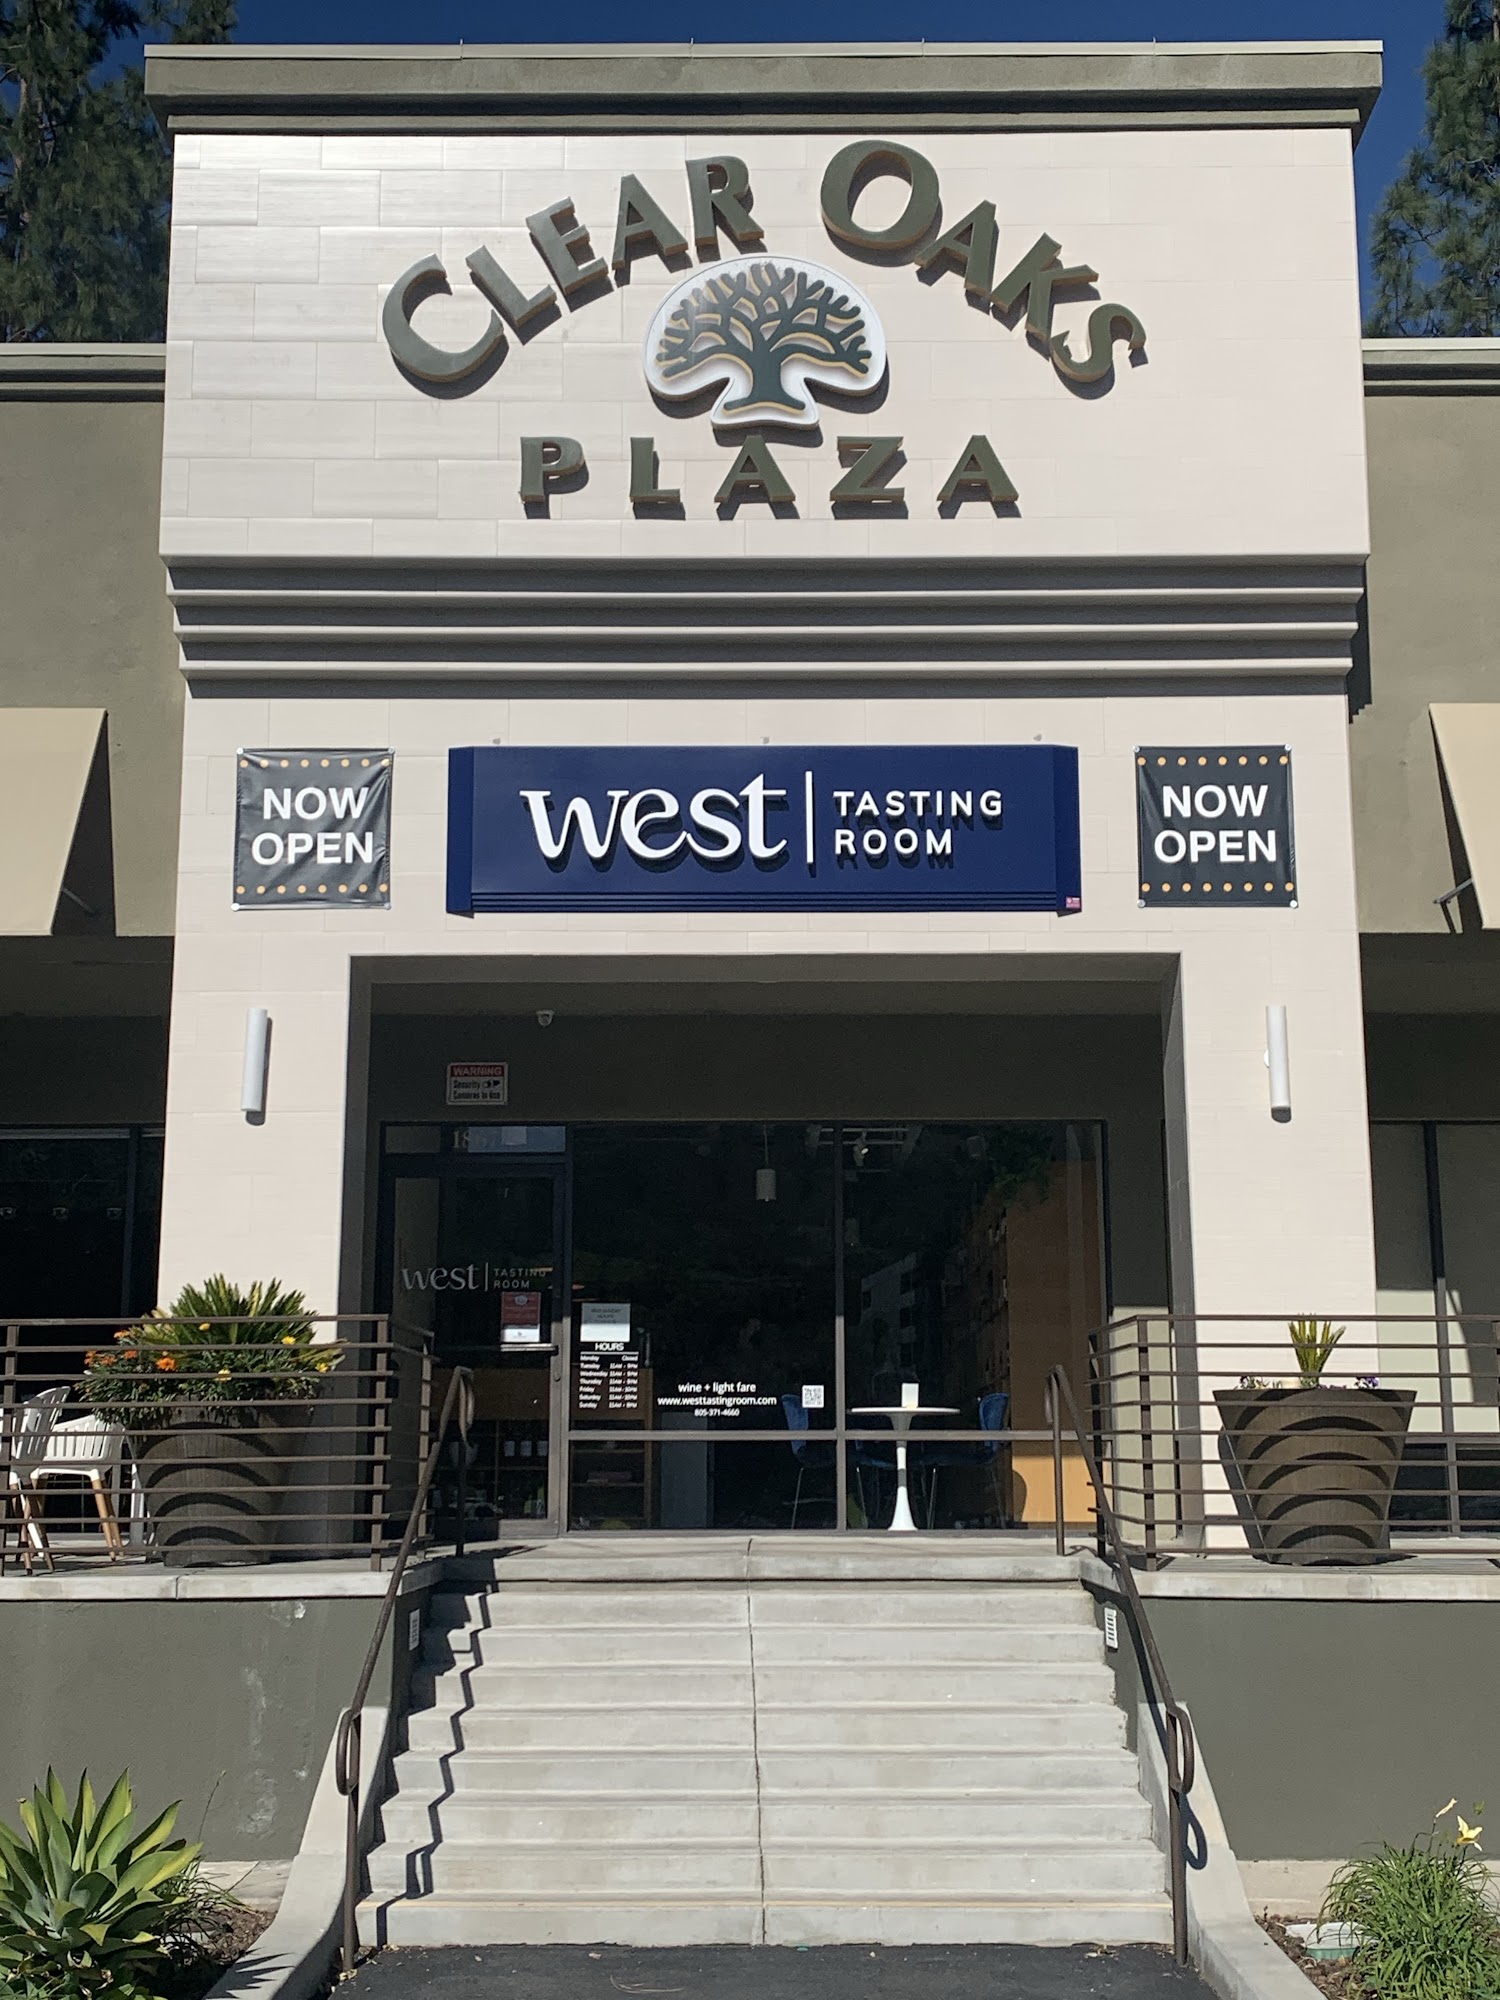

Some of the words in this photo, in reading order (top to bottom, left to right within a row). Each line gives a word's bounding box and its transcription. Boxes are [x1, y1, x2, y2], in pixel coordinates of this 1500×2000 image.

[382, 155, 765, 384] CLEAR
[820, 139, 1146, 383] OAKS
[520, 435, 1019, 504] PLAZA
[262, 786, 369, 820] NOW
[833, 789, 1003, 817] TASTING
[1161, 784, 1268, 818] NOW
[519, 772, 788, 861] west
[250, 831, 374, 865] OPEN
[834, 828, 954, 855] ROOM
[1153, 829, 1278, 863] OPEN
[453, 1066, 502, 1076] WARNING
[400, 1264, 480, 1291] west
[493, 1267, 547, 1277] TASTING
[493, 1279, 530, 1289] ROOM
[595, 1342, 624, 1351] HOURS
[678, 1382, 702, 1392] wine
[712, 1382, 735, 1394] light
[736, 1381, 757, 1392] fare
[657, 1396, 777, 1407] www.westtastingroom.com
